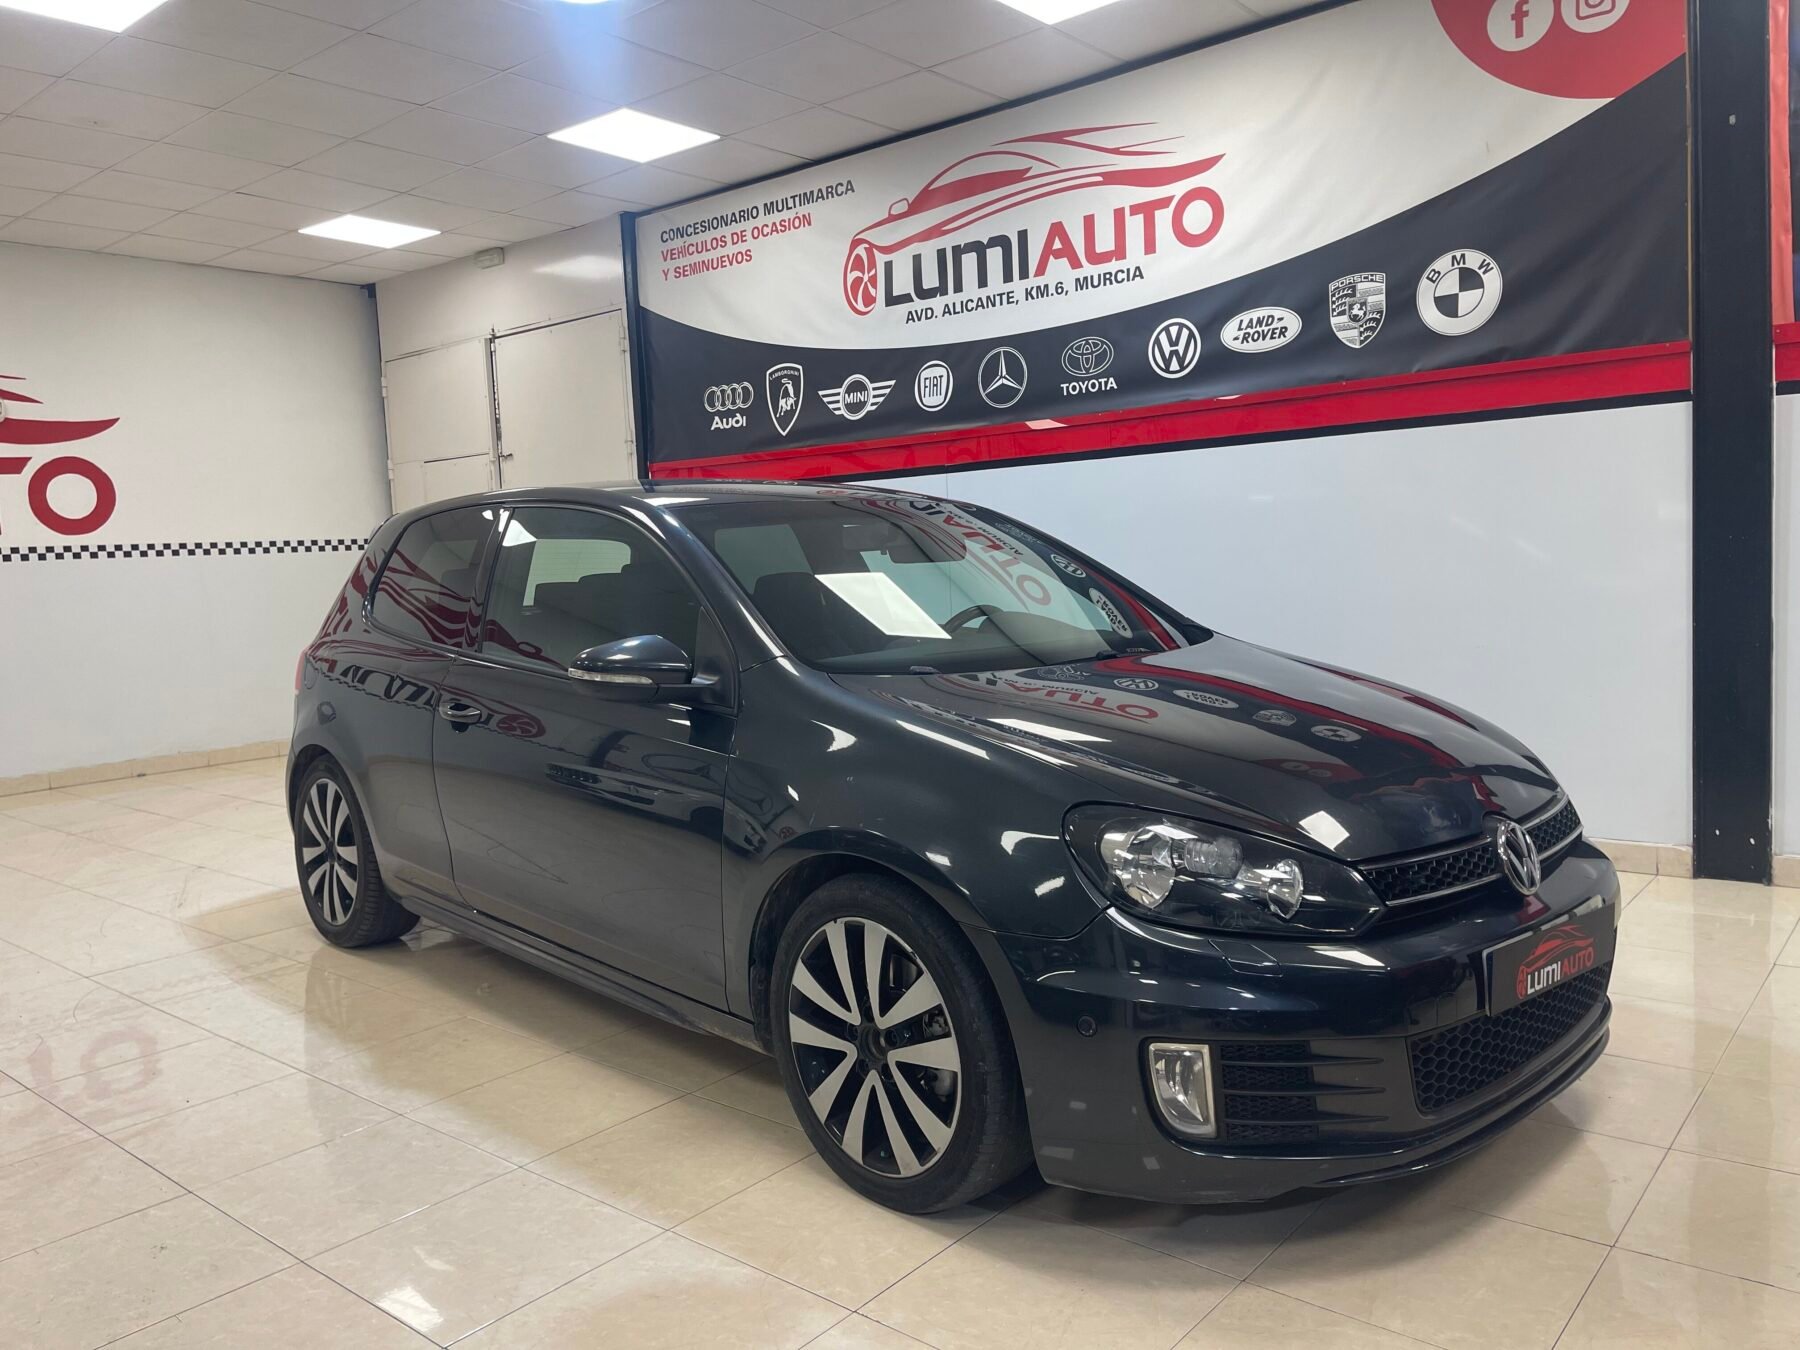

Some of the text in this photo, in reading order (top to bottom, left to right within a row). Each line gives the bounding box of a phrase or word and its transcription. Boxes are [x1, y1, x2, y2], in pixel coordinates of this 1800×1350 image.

[661, 179, 855, 243] CONCESIONARIO MULTIMARCA
[661, 212, 812, 262] VEHÍCULOS DE OCASIÓN
[662, 249, 753, 281] Y SEMINUEVOS
[1425, 252, 1494, 284] BMW
[905, 265, 1145, 324] AVD. ALICANTE, KM.6, MURCIA
[1331, 274, 1384, 291] PORSCHE
[844, 390, 869, 404] MINI
[923, 374, 944, 399] FIAT
[1060, 377, 1118, 396] TOYOTA
[710, 413, 747, 431] Audi
